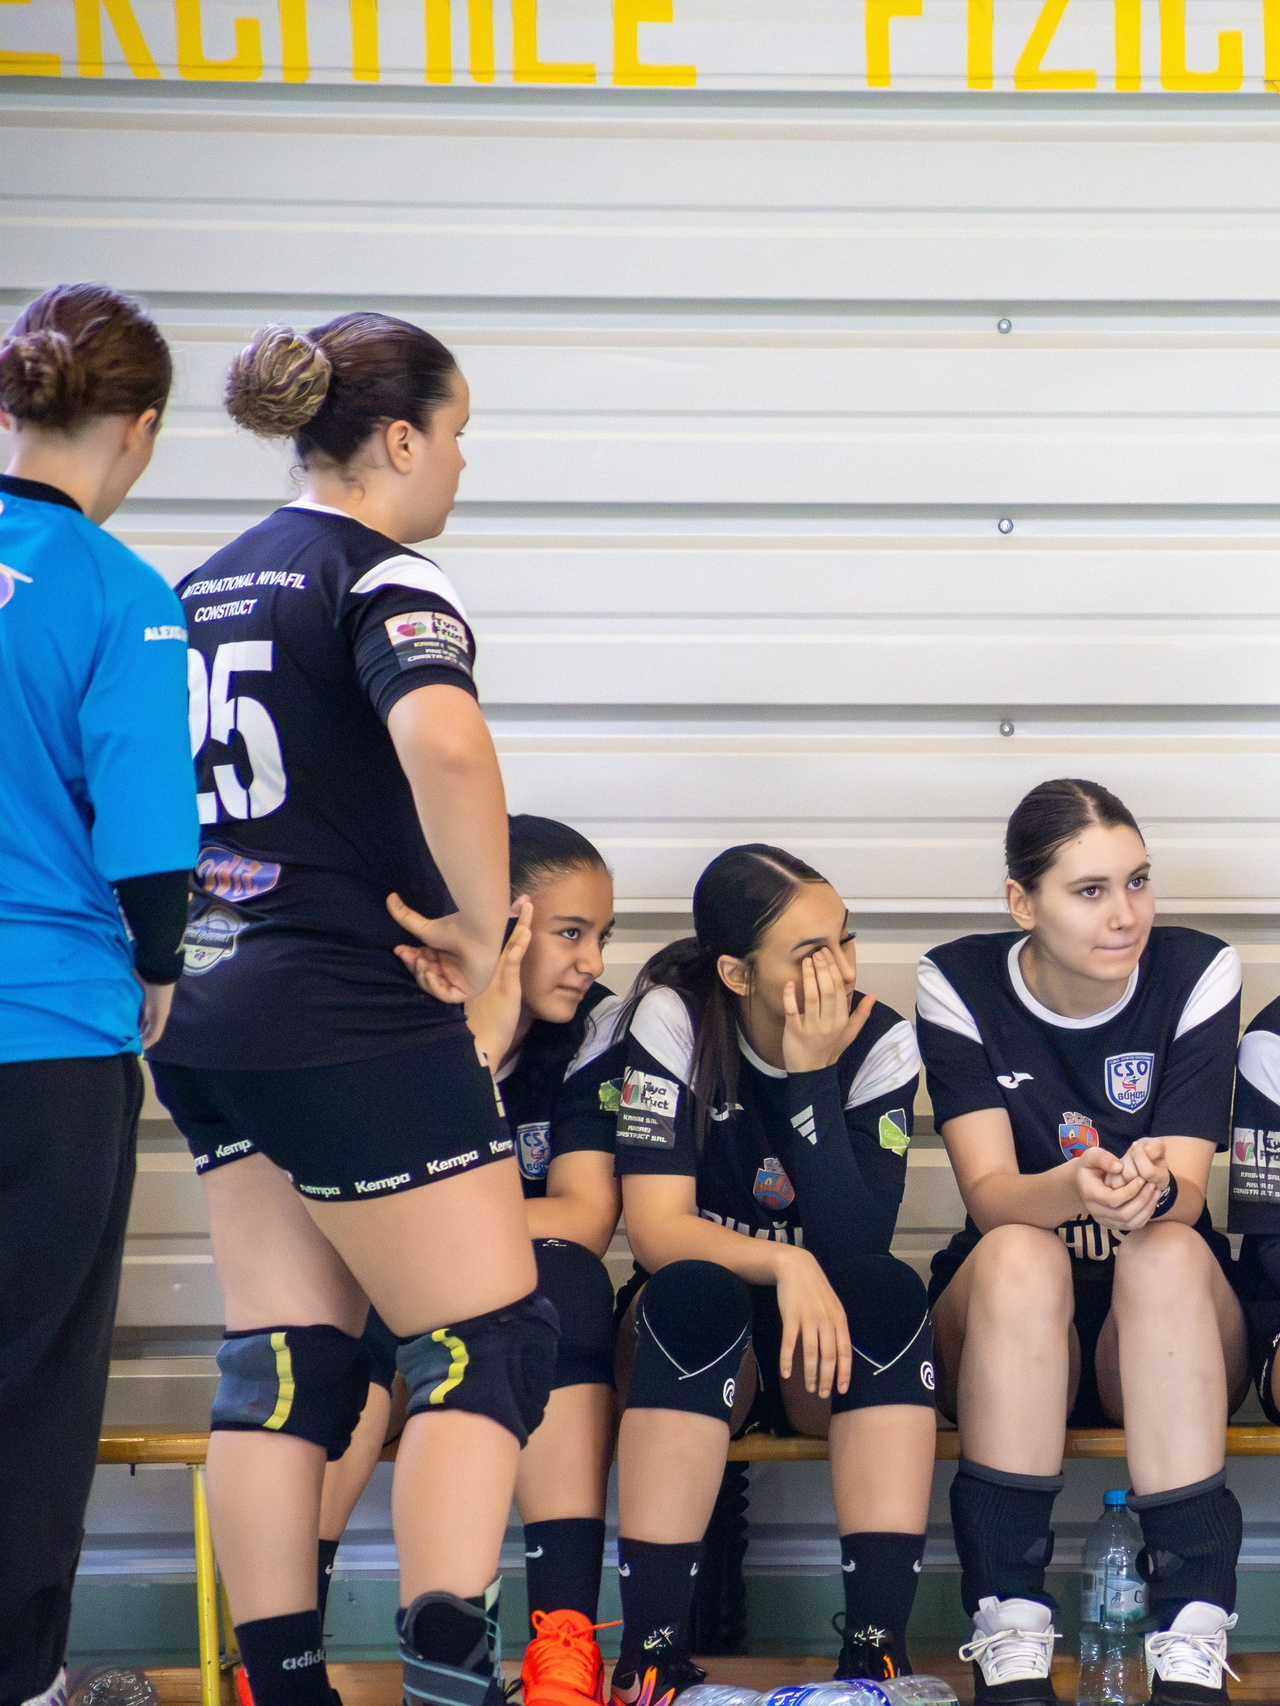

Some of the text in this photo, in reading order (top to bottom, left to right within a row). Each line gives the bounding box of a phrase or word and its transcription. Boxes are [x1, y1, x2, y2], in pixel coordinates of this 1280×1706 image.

[255, 570, 306, 590] NIVAFIL
[194, 599, 258, 623] CONSTRUCT
[1113, 1061, 1149, 1078] CSO
[426, 1150, 479, 1175] Kempa
[354, 1172, 412, 1194] Kempa
